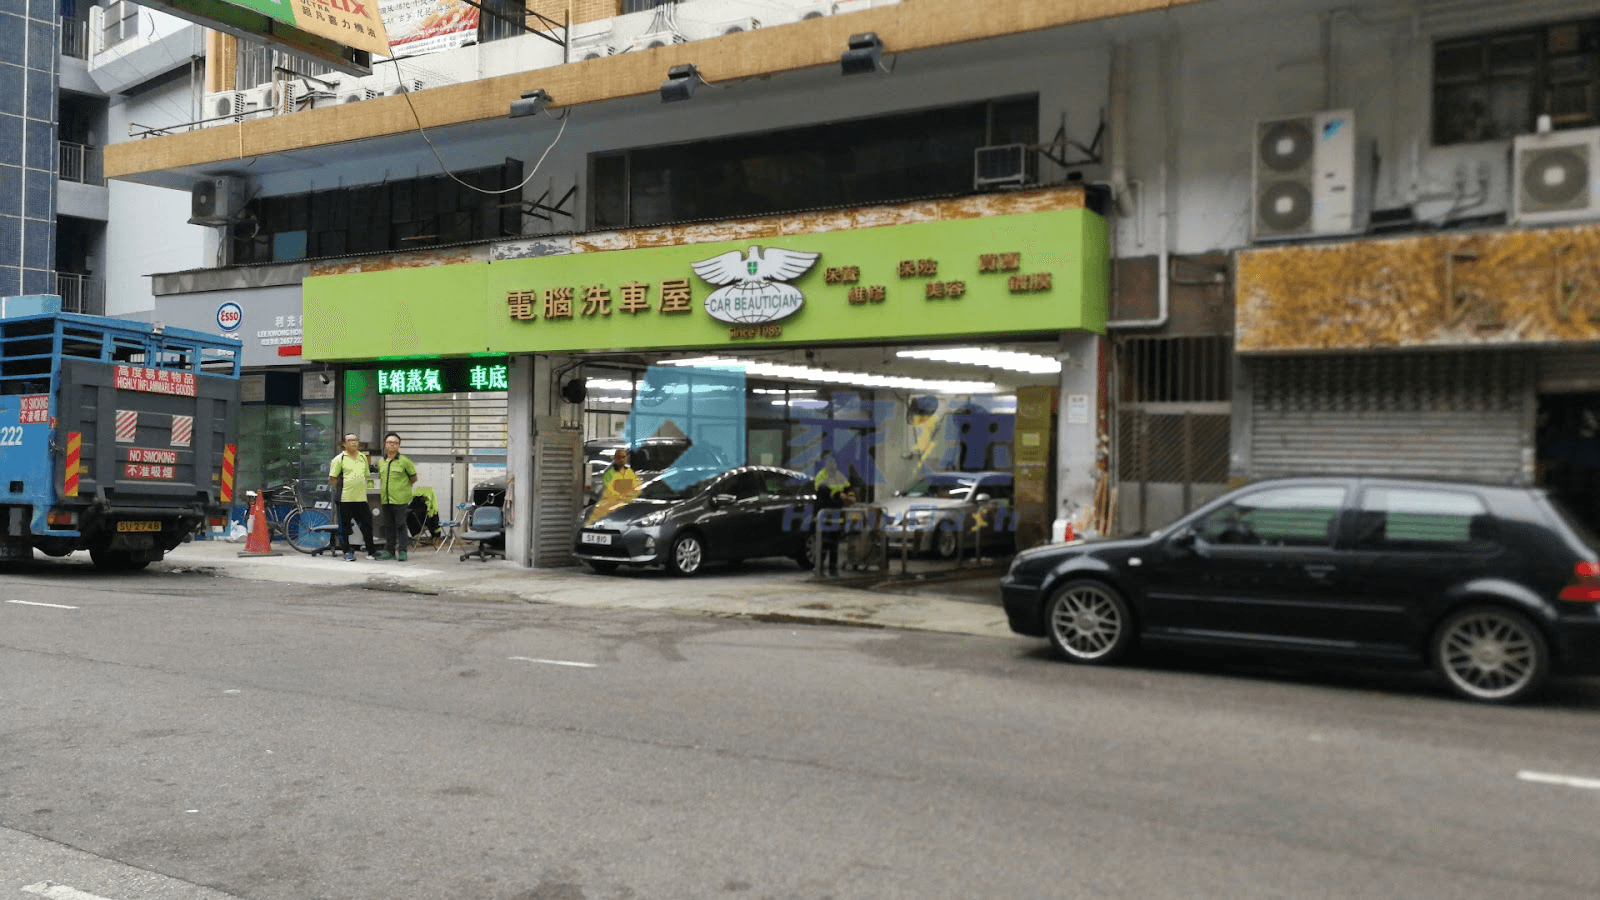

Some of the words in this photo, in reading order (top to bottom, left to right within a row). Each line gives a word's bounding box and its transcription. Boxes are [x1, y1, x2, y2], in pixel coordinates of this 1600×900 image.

[505, 278, 692, 321] 電腦洗車屋
[709, 298, 731, 312] CAR
[734, 294, 798, 311] BEAUTICIAN
[257, 330, 268, 338] LEE
[290, 328, 303, 337] HON
[118, 366, 194, 385] 高度易燃物品
[469, 364, 508, 390] 車底
[117, 376, 137, 390] HIGHLY
[138, 379, 175, 394] INFLAMMABLE
[175, 383, 194, 397] GOODS
[21, 398, 29, 411] NO
[28, 396, 48, 410] SMOKING
[20, 410, 48, 422] 不准吸煙
[129, 450, 142, 462] NO
[143, 450, 176, 464] SMOKING
[127, 464, 173, 479] 不准吸煙
